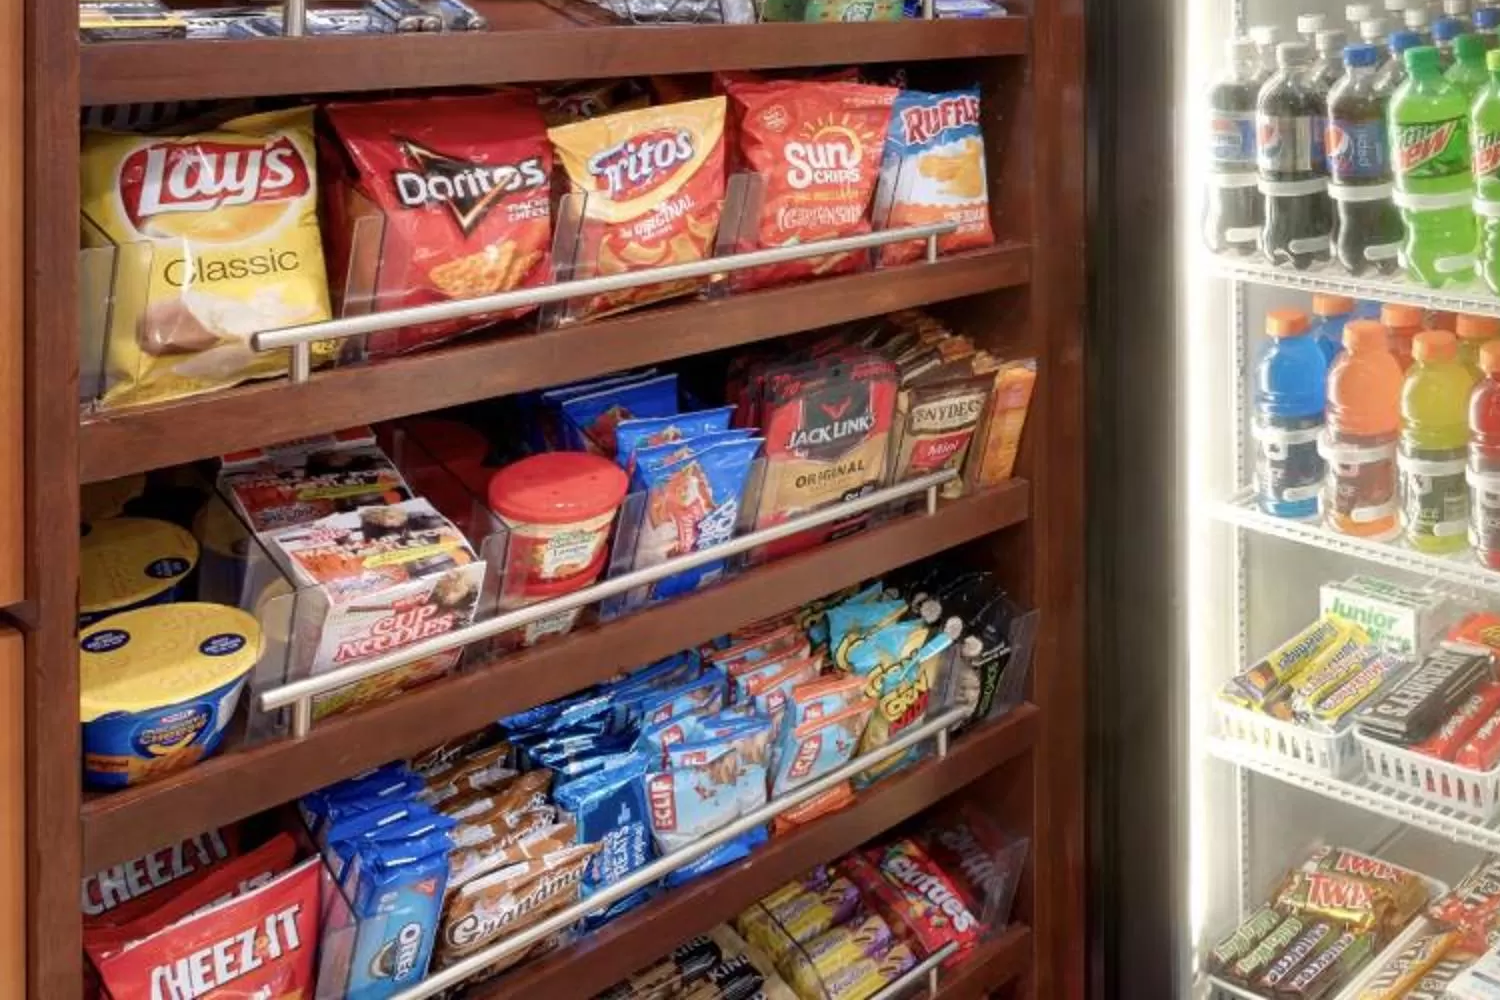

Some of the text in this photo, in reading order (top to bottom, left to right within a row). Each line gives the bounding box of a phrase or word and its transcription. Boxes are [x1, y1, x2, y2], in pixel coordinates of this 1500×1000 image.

[395, 157, 548, 208] Doritos
[587, 130, 695, 199] Fritos
[784, 141, 862, 189] Sun
[813, 168, 861, 184] CHIPS
[162, 247, 300, 288] Classic
[785, 423, 833, 450] JACK
[795, 459, 866, 489] ORIGINAL
[372, 604, 439, 637] CUP
[1331, 596, 1399, 630] Junior
[334, 614, 454, 664] NOODLES
[1305, 871, 1375, 910] TWIX
[394, 923, 422, 983] OREO
[708, 953, 749, 980] KIND
